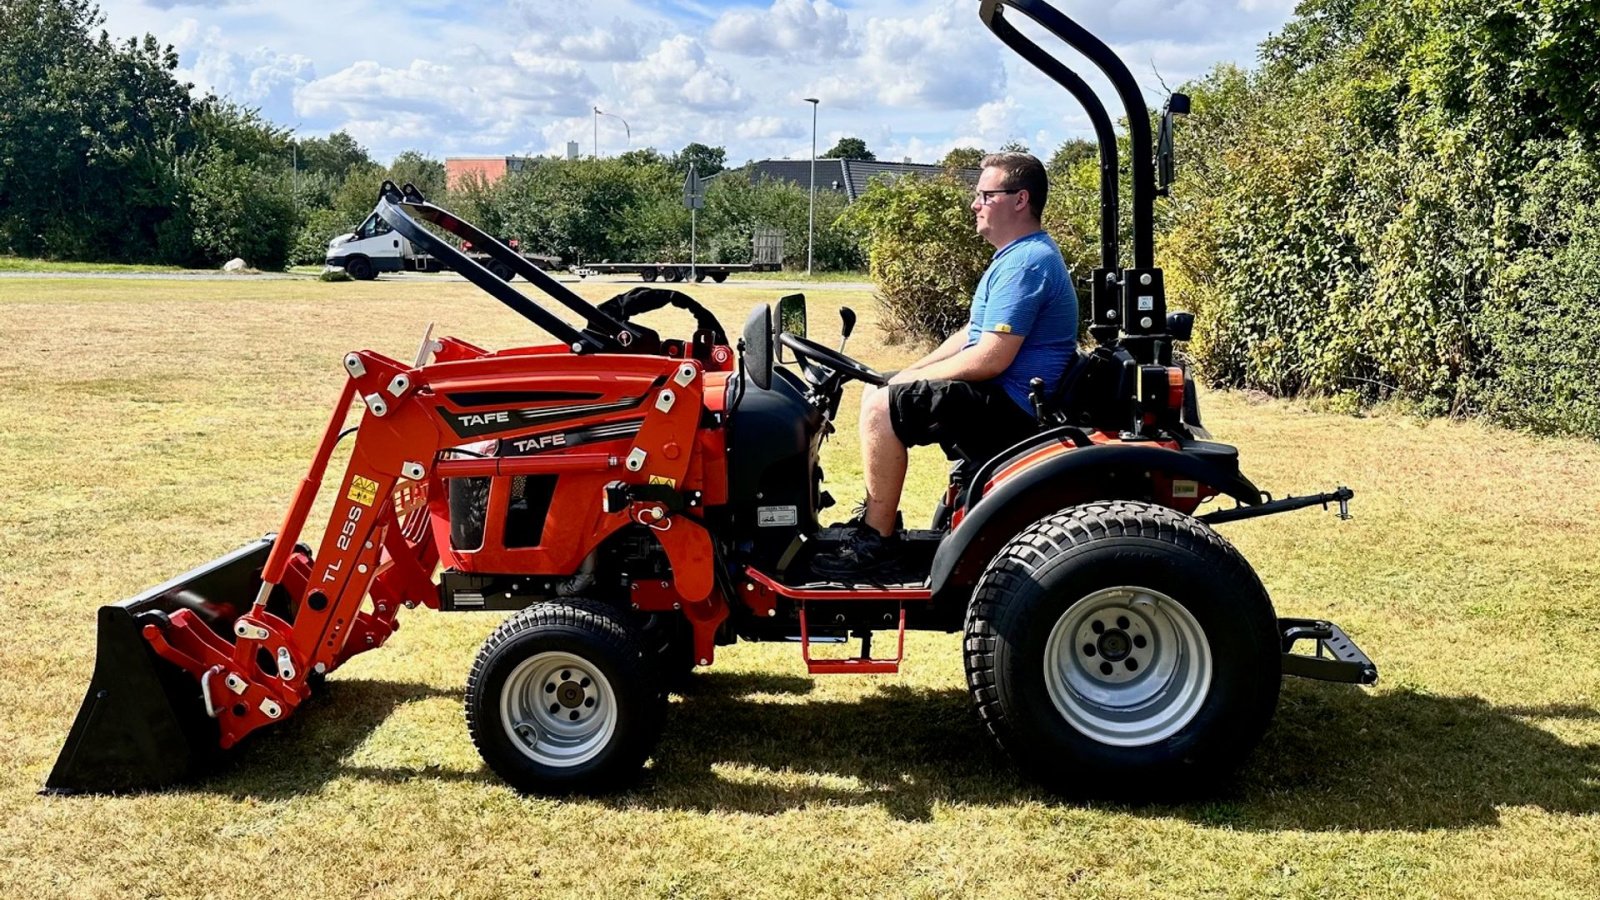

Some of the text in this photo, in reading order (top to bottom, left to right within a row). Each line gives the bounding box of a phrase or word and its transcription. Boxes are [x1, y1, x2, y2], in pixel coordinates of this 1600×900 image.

[458, 411, 510, 427] TAFE
[513, 433, 566, 452] TAFE
[322, 505, 363, 583] TL 25S
